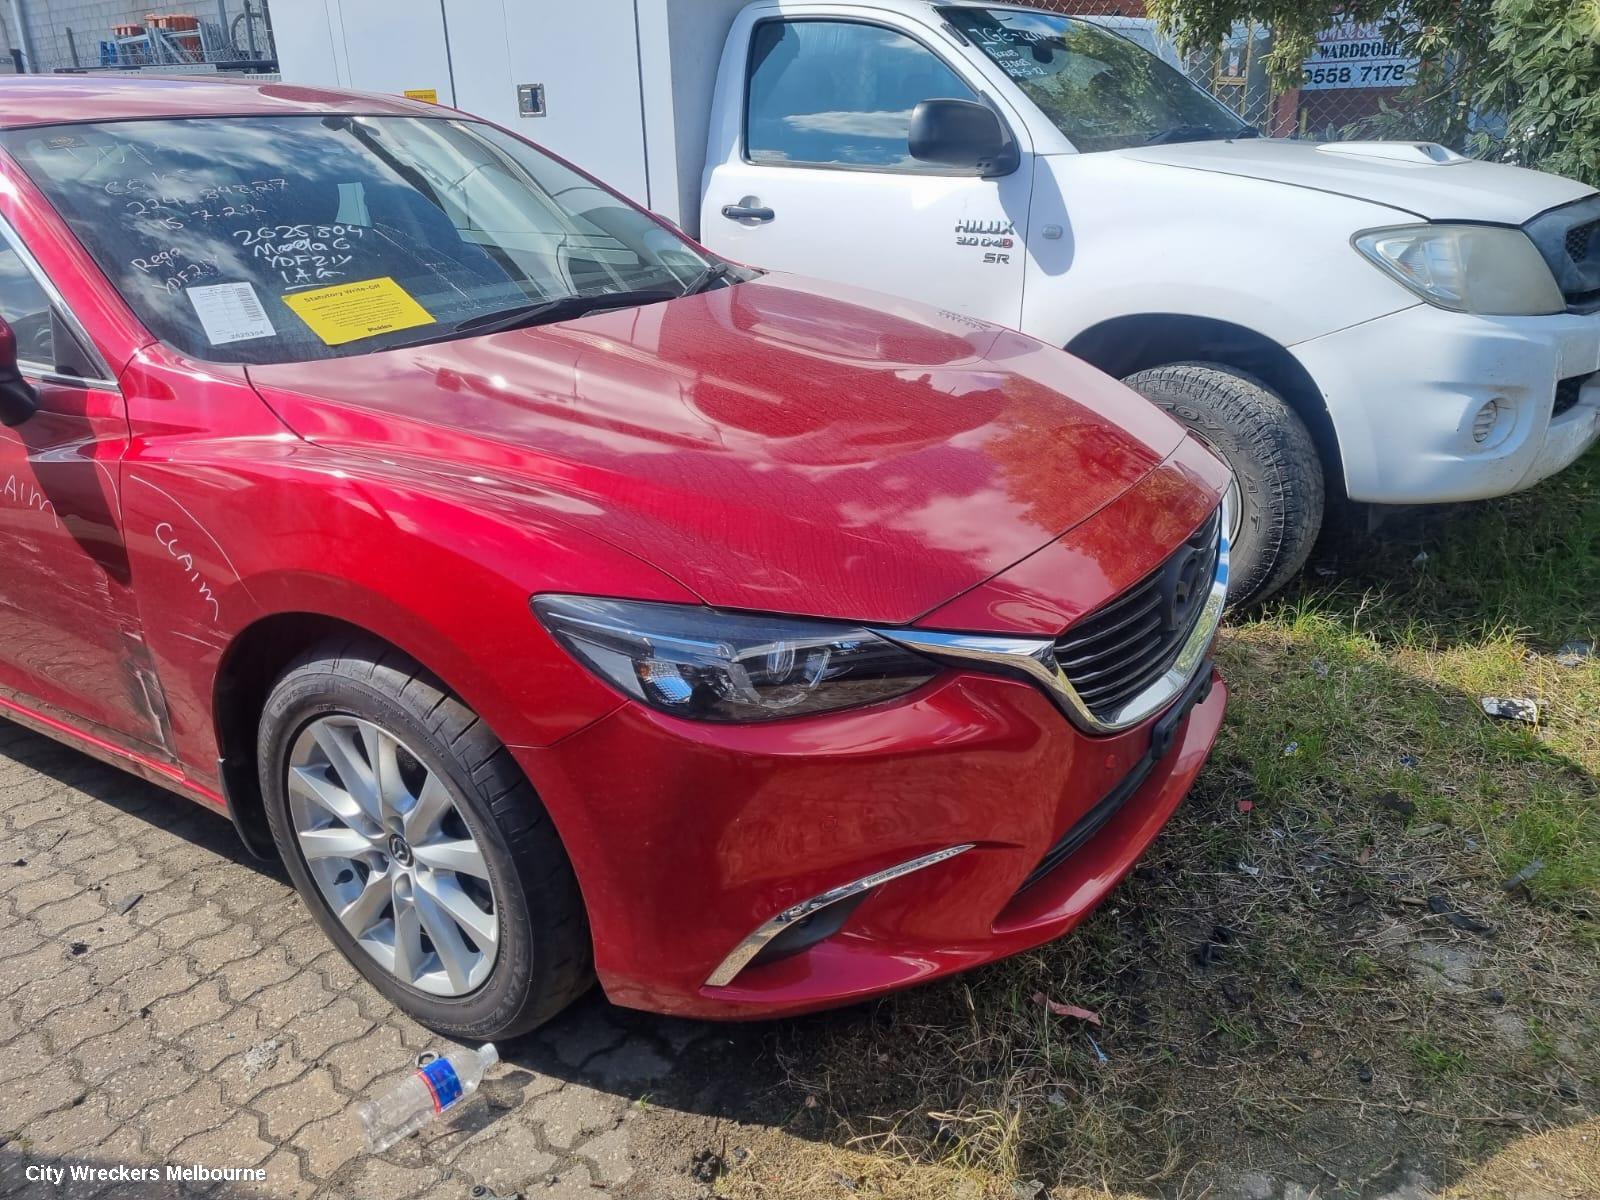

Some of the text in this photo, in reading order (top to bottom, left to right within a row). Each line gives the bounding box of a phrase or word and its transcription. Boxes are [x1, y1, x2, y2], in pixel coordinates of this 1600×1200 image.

[1361, 64, 1405, 82] 7178
[955, 219, 1015, 235] HILUX
[982, 252, 1010, 264] SR
